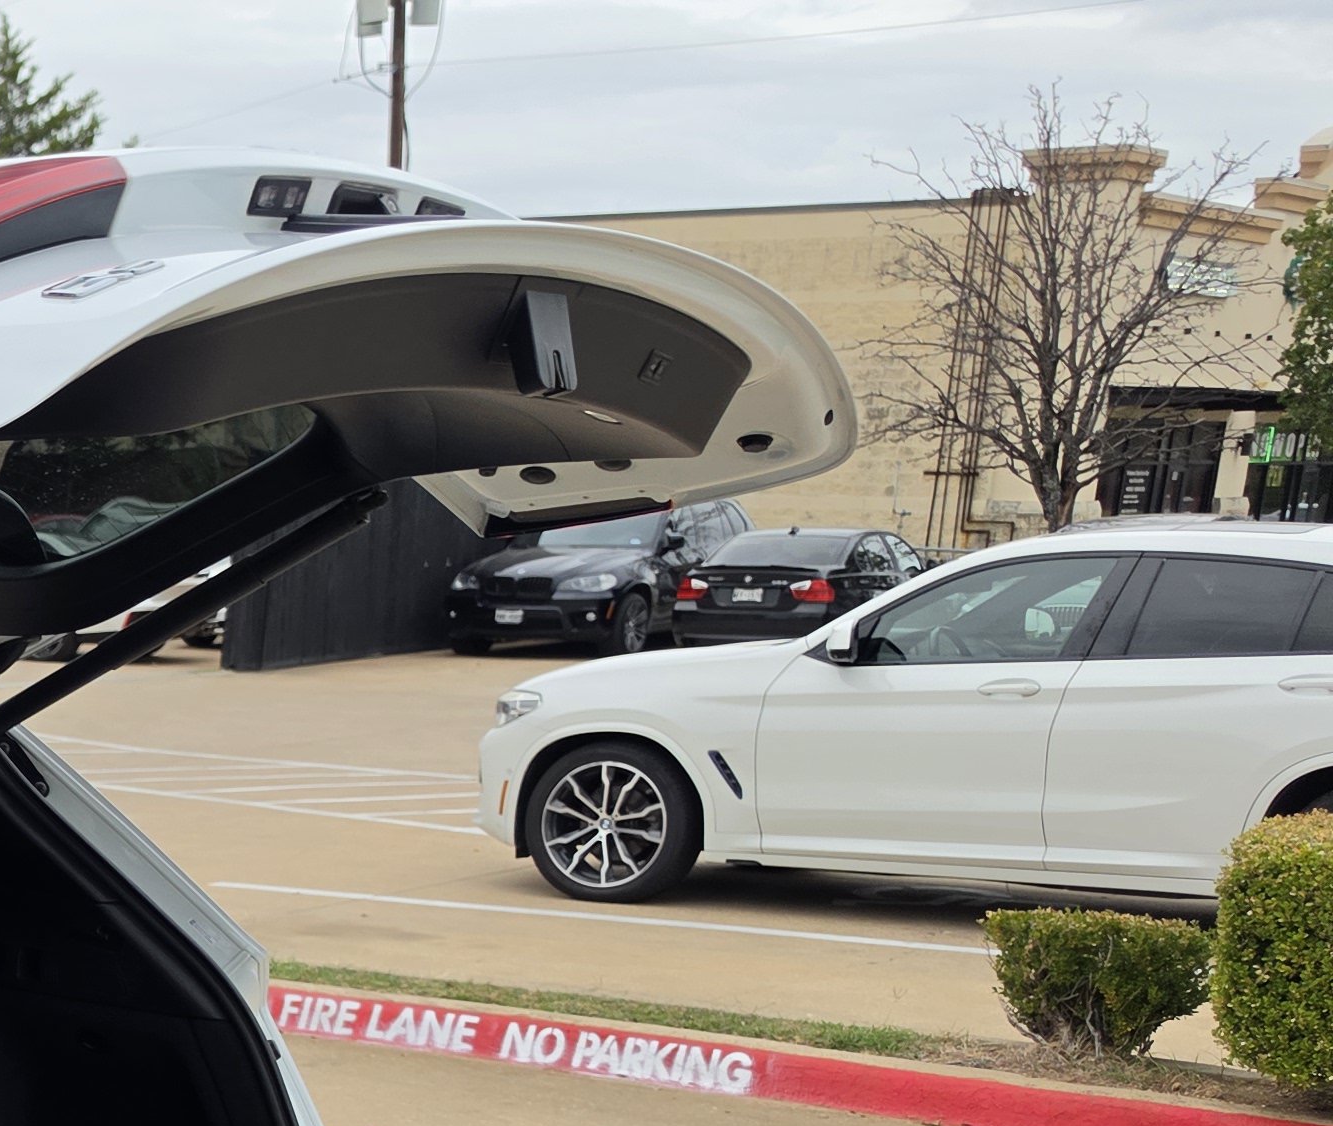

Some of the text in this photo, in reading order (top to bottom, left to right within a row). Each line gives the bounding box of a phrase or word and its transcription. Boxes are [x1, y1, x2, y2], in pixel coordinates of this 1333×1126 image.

[278, 993, 753, 1094] FIRE LANE NO PARKING
